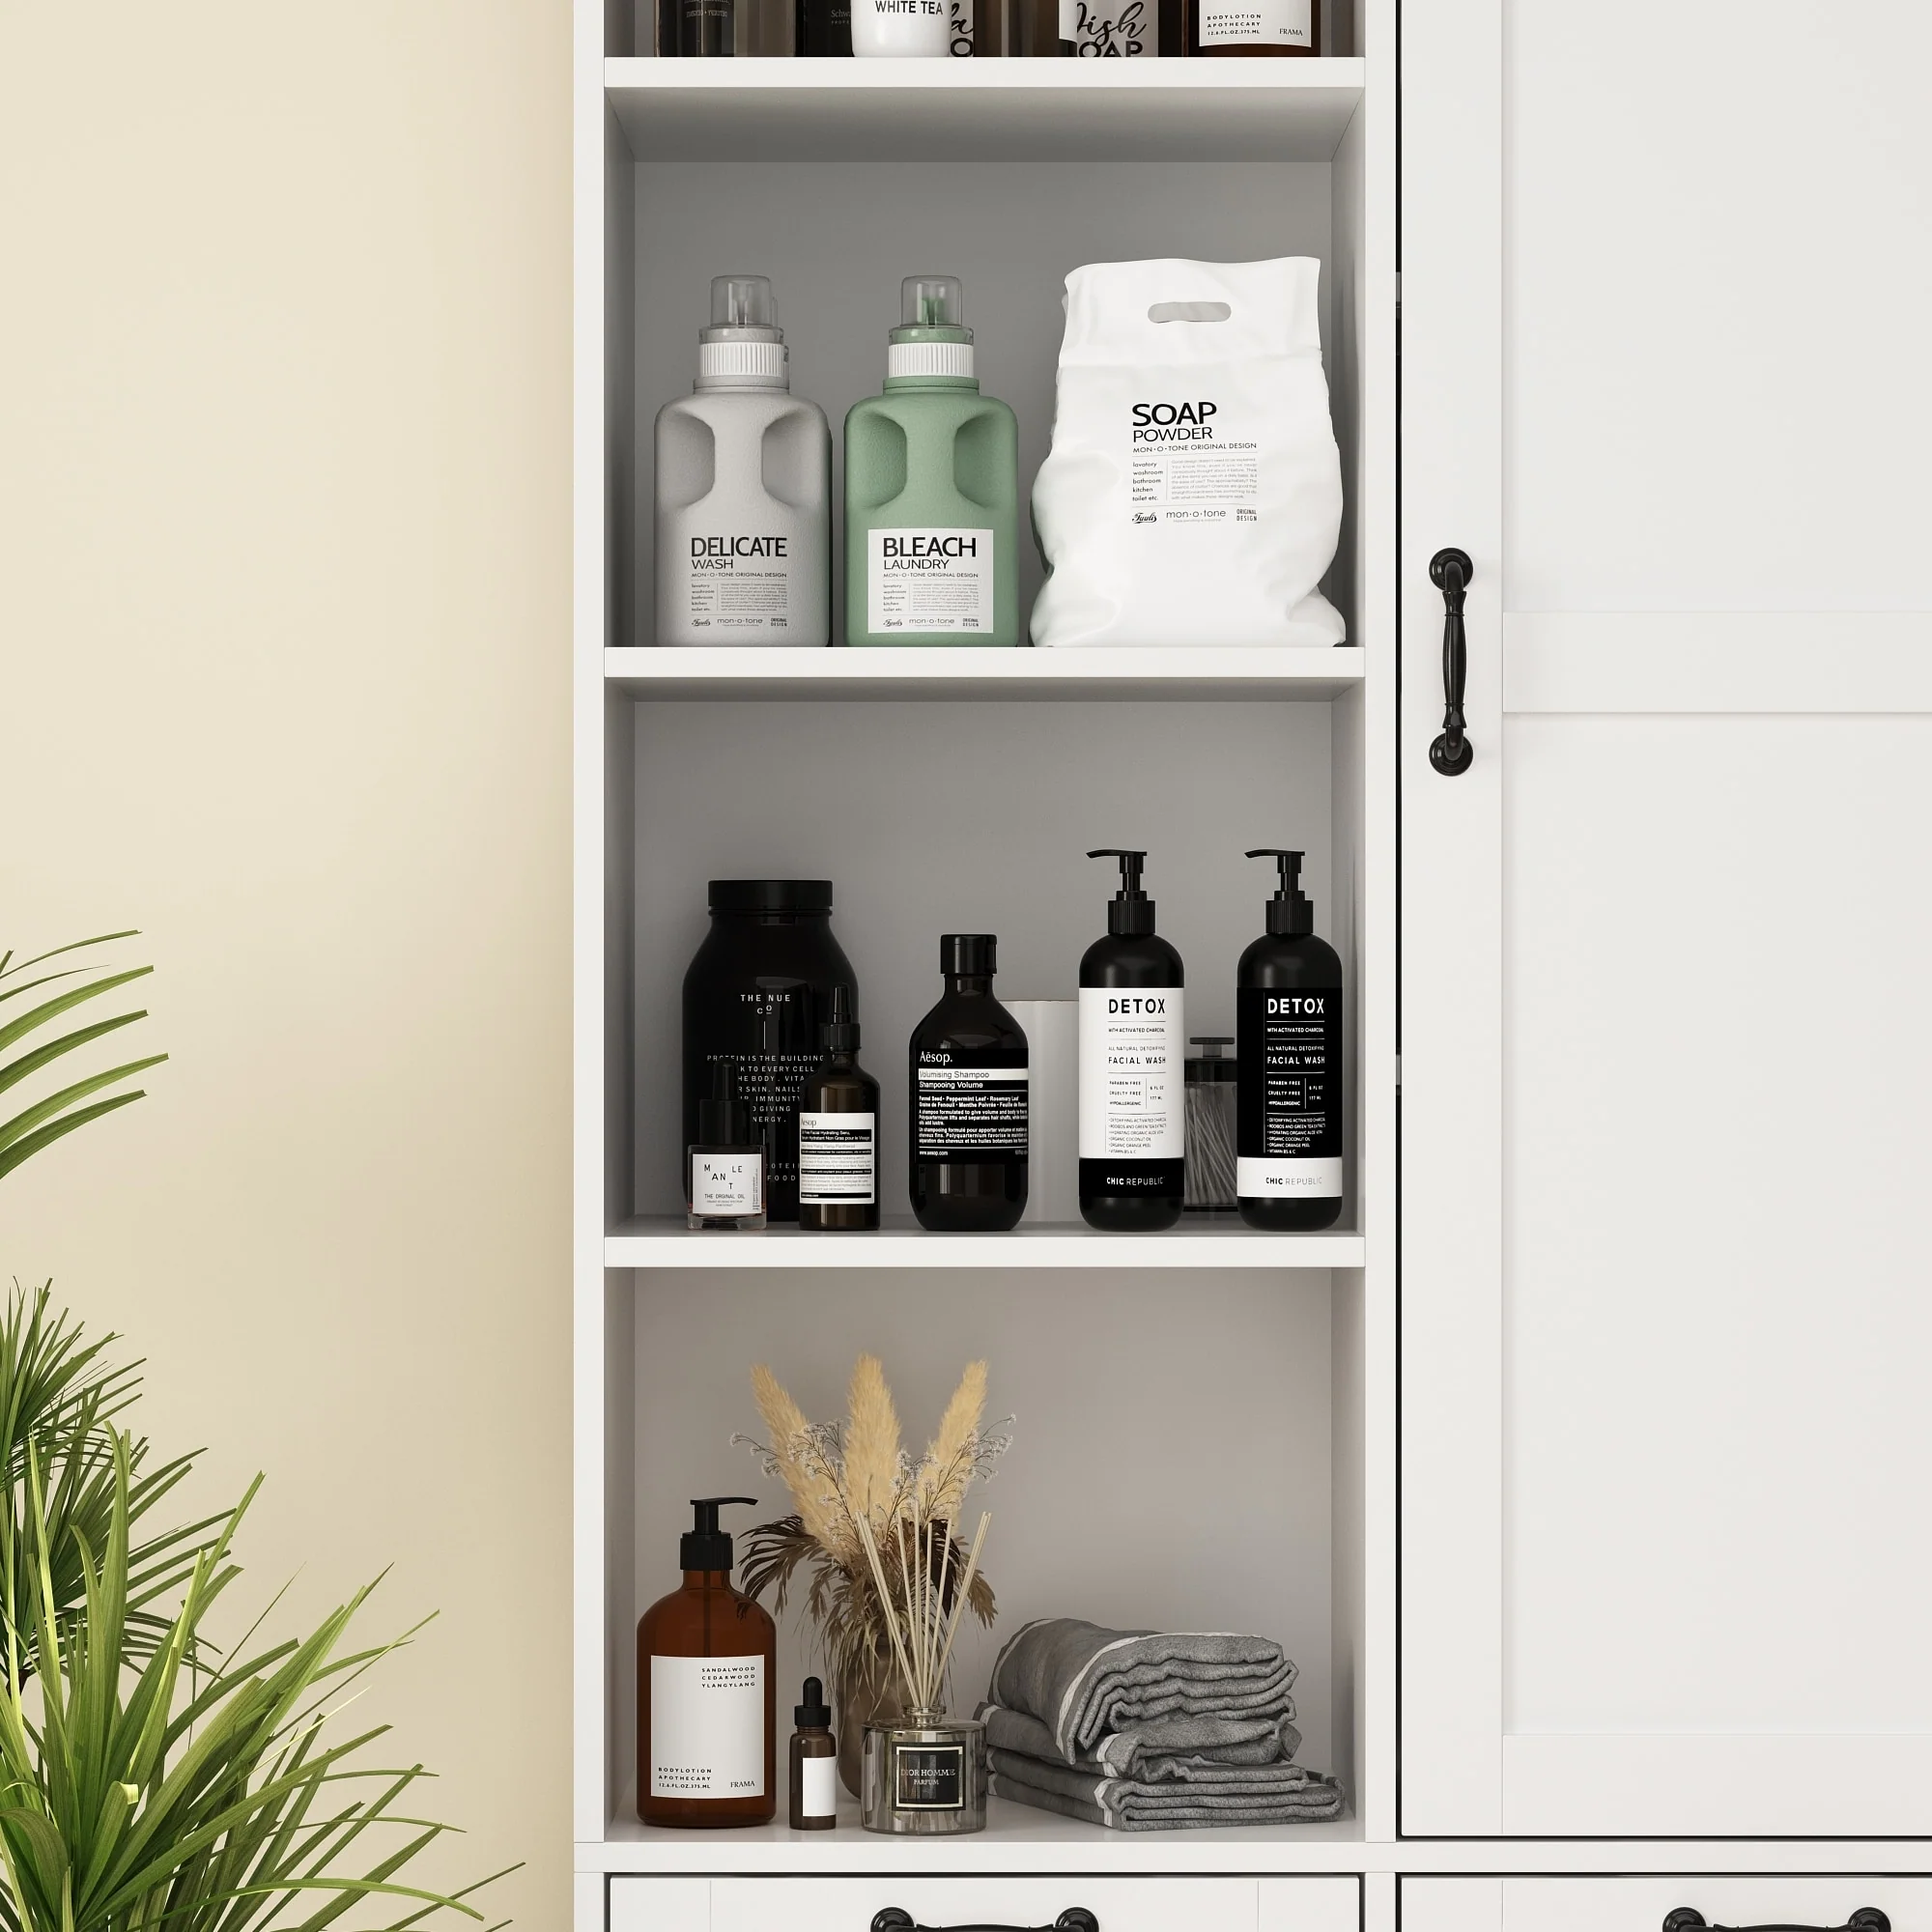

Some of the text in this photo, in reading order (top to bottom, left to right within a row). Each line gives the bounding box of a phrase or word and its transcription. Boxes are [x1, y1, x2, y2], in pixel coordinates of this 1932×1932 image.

[875, 1, 944, 14] WHITE TEA
[1279, 28, 1303, 37] FRAMA
[1079, 41, 1143, 57] OAP
[1132, 402, 1217, 427] SOAP
[1133, 427, 1213, 442] POWDER
[691, 537, 787, 557] DELICATE
[883, 537, 977, 557] BLEACH
[692, 558, 733, 570] WASH
[884, 558, 950, 570] LAUNDRY
[1108, 998, 1165, 1014] DETOX
[1267, 998, 1324, 1014] DETOX
[1108, 1056, 1166, 1065] FACIAL WASH
[1266, 1056, 1325, 1065] FACIAL WASH
[919, 1070, 990, 1080] Volumising Shampoo
[919, 1081, 955, 1090] Shampooing
[1106, 1177, 1164, 1186] CHIC REPUBLIC
[1265, 1177, 1322, 1186] CHIC REPUBLIC
